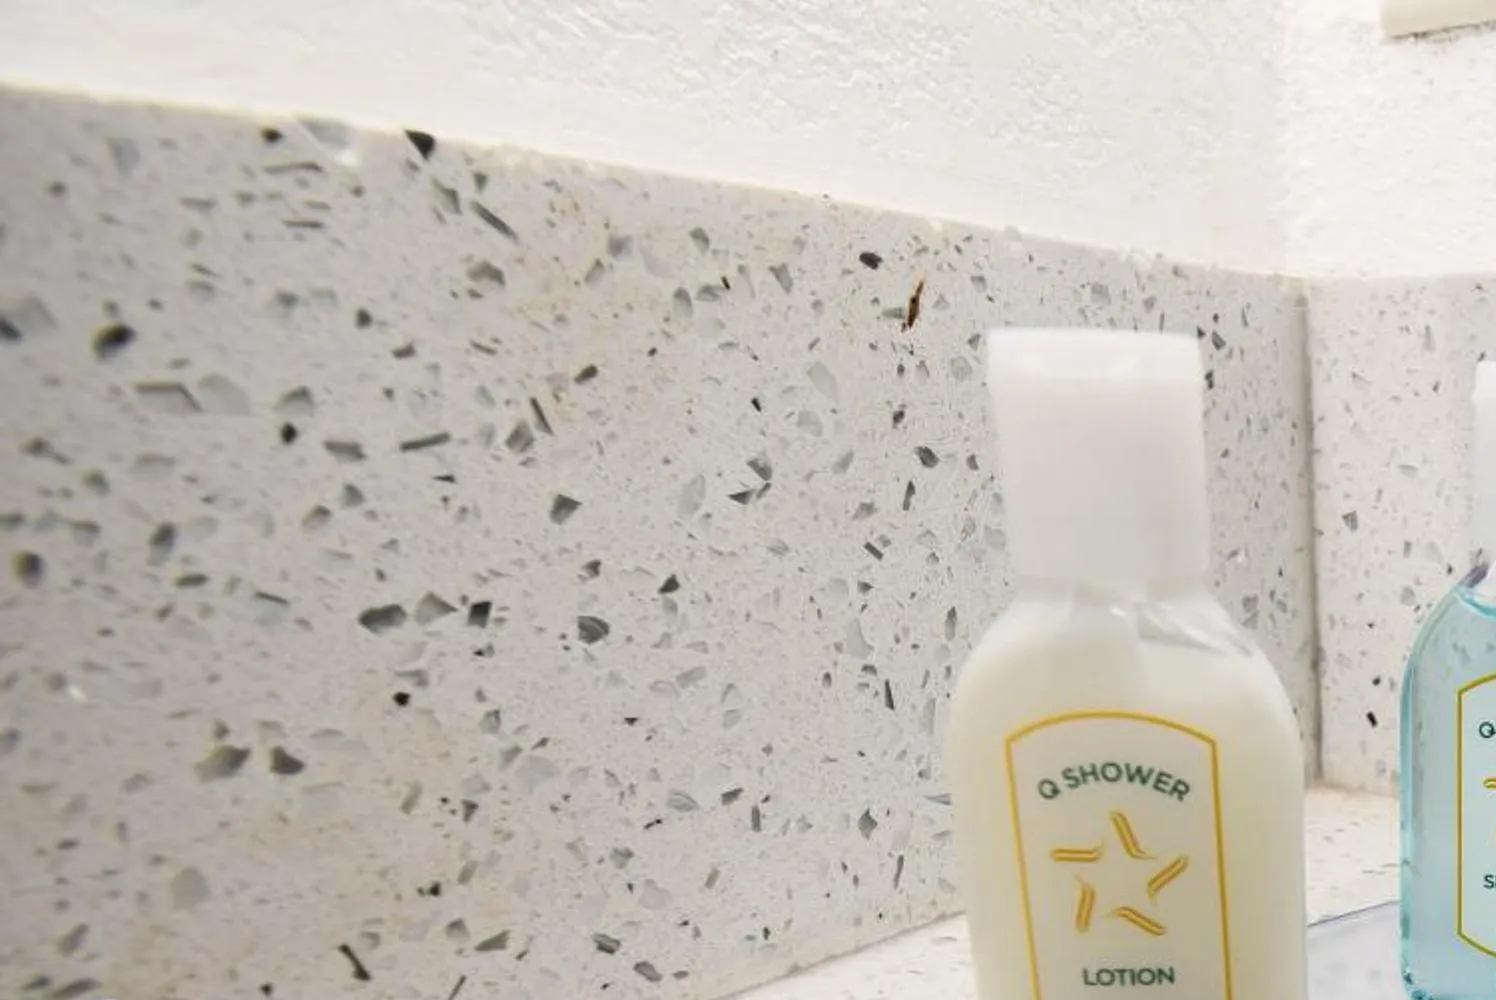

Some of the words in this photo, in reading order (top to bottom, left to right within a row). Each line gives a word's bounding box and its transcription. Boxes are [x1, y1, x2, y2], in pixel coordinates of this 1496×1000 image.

[1478, 721, 1496, 739] Q
[1037, 778, 1061, 801] Q
[1062, 762, 1191, 801] SHOWER
[1083, 967, 1176, 987] LOTION
